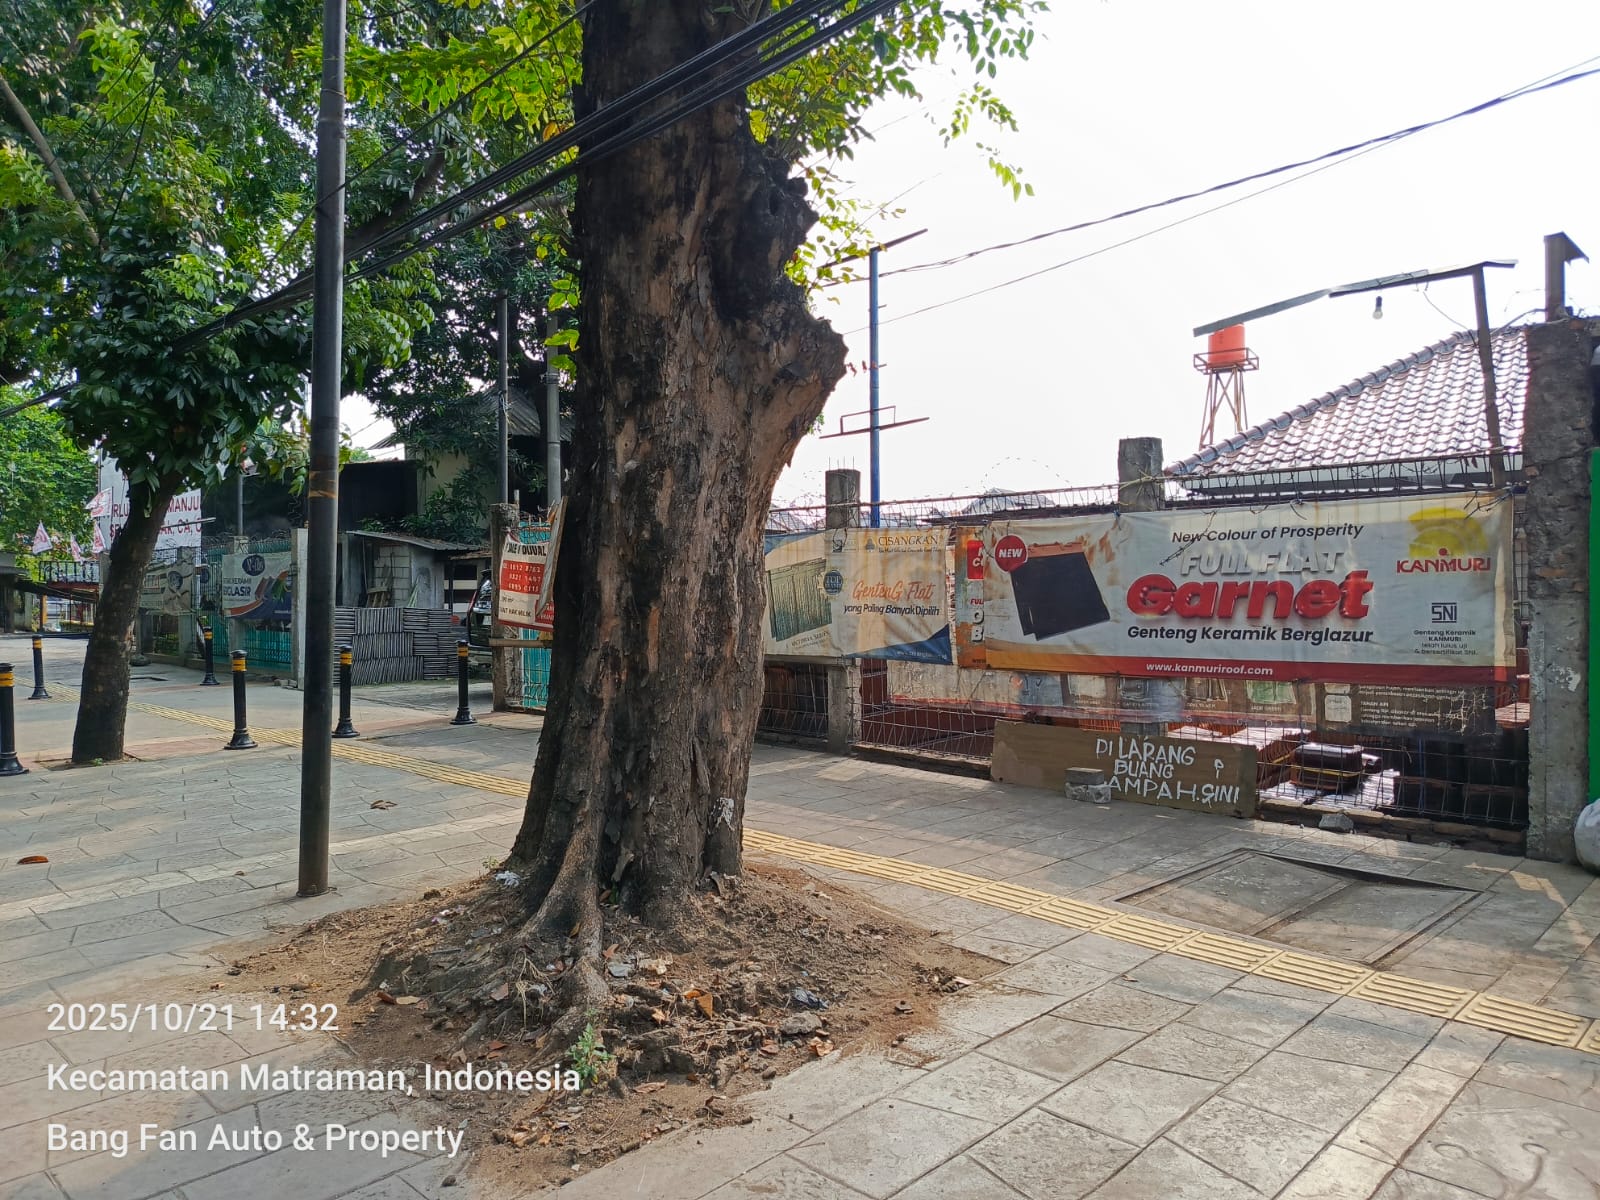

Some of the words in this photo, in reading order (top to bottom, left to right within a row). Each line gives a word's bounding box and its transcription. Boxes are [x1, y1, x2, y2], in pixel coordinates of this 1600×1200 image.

[878, 535, 938, 546] CISANGKAN
[1172, 531, 1201, 543] New
[1207, 529, 1256, 542] Colour
[1262, 528, 1277, 539] of
[1280, 524, 1364, 541] Prosperity
[998, 548, 1022, 558] NEW
[1180, 551, 1250, 576] FULL
[1258, 551, 1346, 574] FLAT
[1396, 558, 1491, 573] KANMURI
[907, 581, 936, 601] Flat
[1126, 570, 1374, 620] Garnet
[844, 604, 862, 615] yang
[863, 604, 885, 615] Paling
[885, 604, 916, 617] Banyak
[916, 605, 940, 617] Dipilih
[1432, 602, 1457, 623] SNI
[1127, 625, 1196, 643] Genteng
[1201, 626, 1277, 641] Keramik
[1281, 628, 1374, 646] Berglazur
[1146, 662, 1273, 676] www.kanmuriroof.com
[1095, 738, 1113, 759] DI
[1118, 736, 1197, 766] LARANG
[1114, 758, 1175, 779] BUANG
